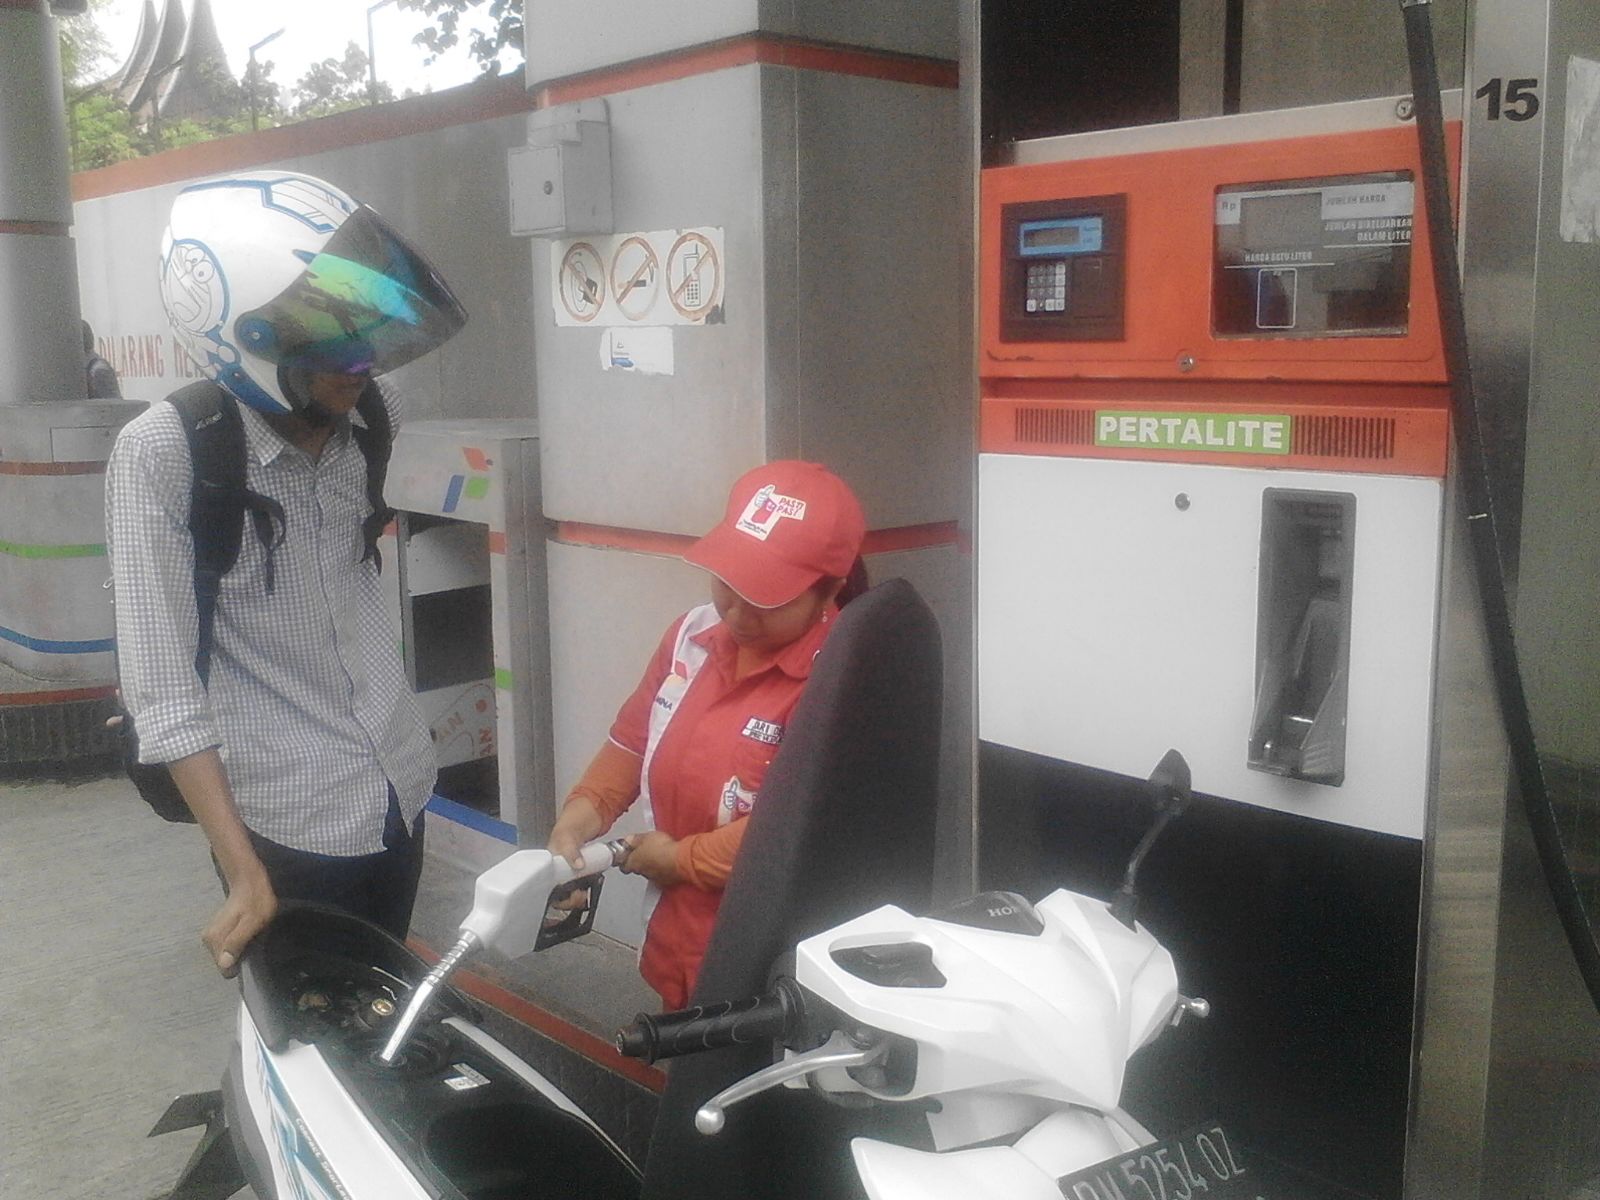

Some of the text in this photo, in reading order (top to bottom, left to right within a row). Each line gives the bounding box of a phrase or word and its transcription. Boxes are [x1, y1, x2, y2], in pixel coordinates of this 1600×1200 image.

[1476, 78, 1539, 122] 15
[1222, 201, 1237, 211] Rp
[1099, 415, 1284, 449] PERTALITE
